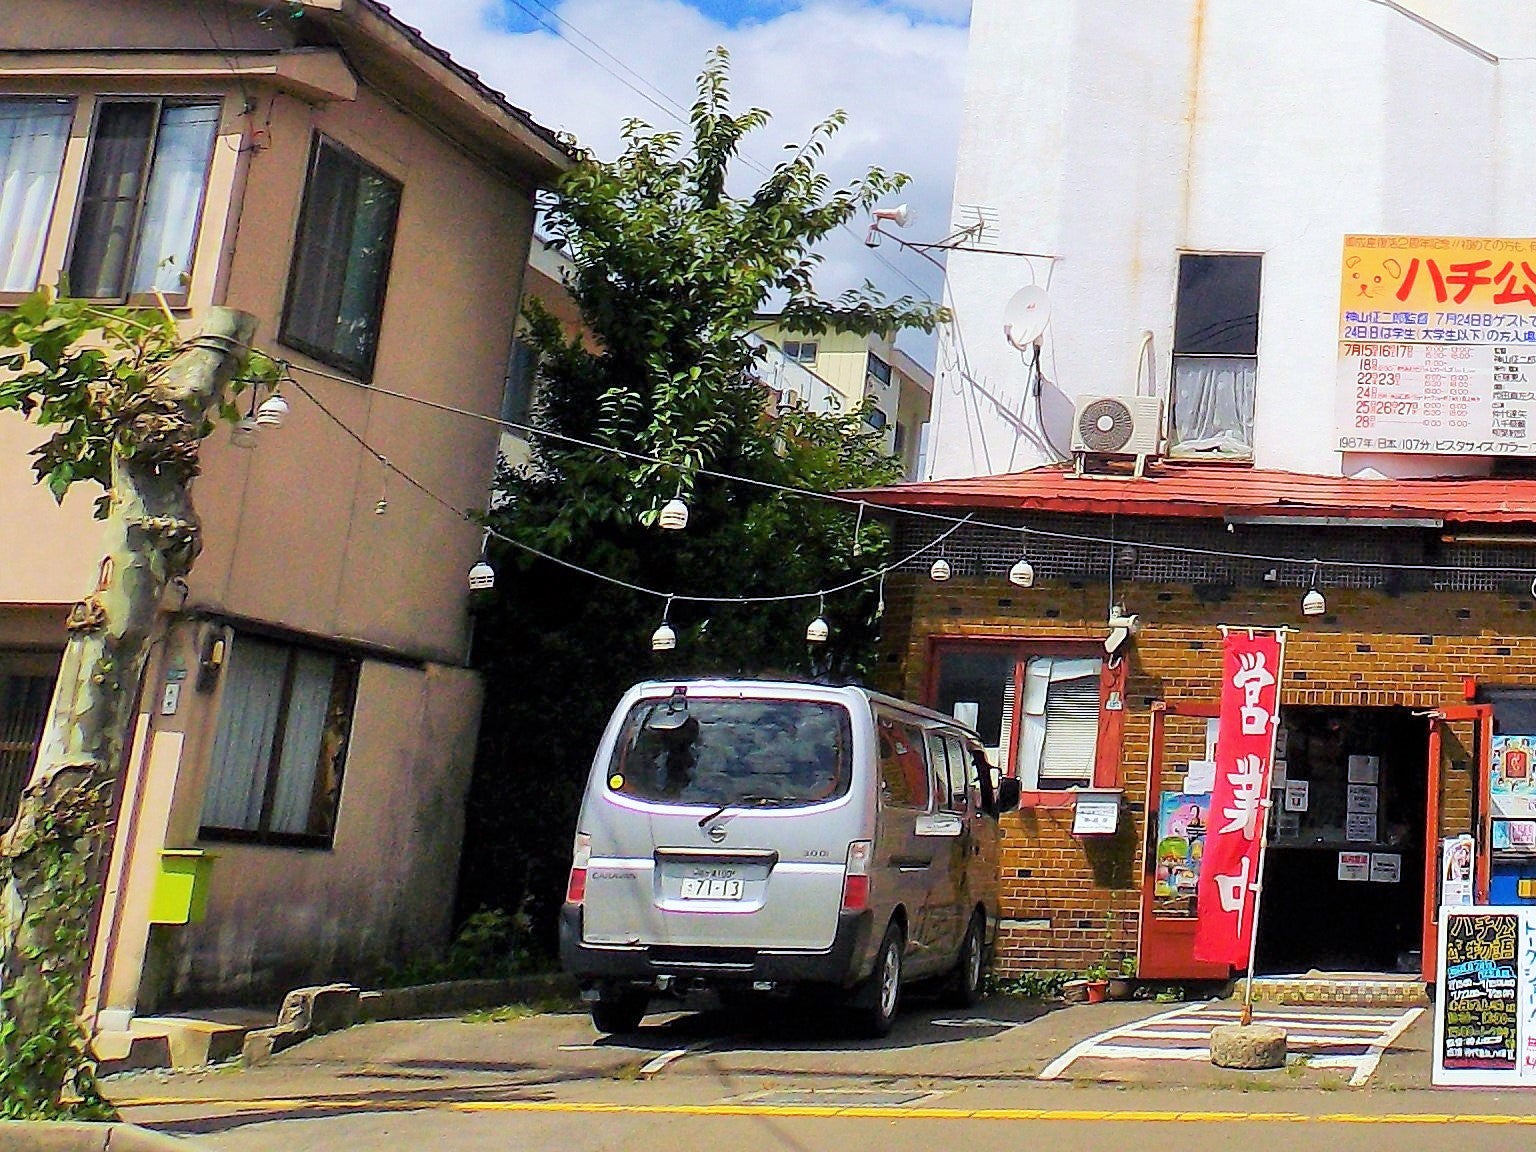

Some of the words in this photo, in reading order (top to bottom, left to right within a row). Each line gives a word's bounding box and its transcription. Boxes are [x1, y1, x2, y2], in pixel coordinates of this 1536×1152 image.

[1214, 651, 1276, 940] 営業中
[696, 879, 740, 897] 71-13
